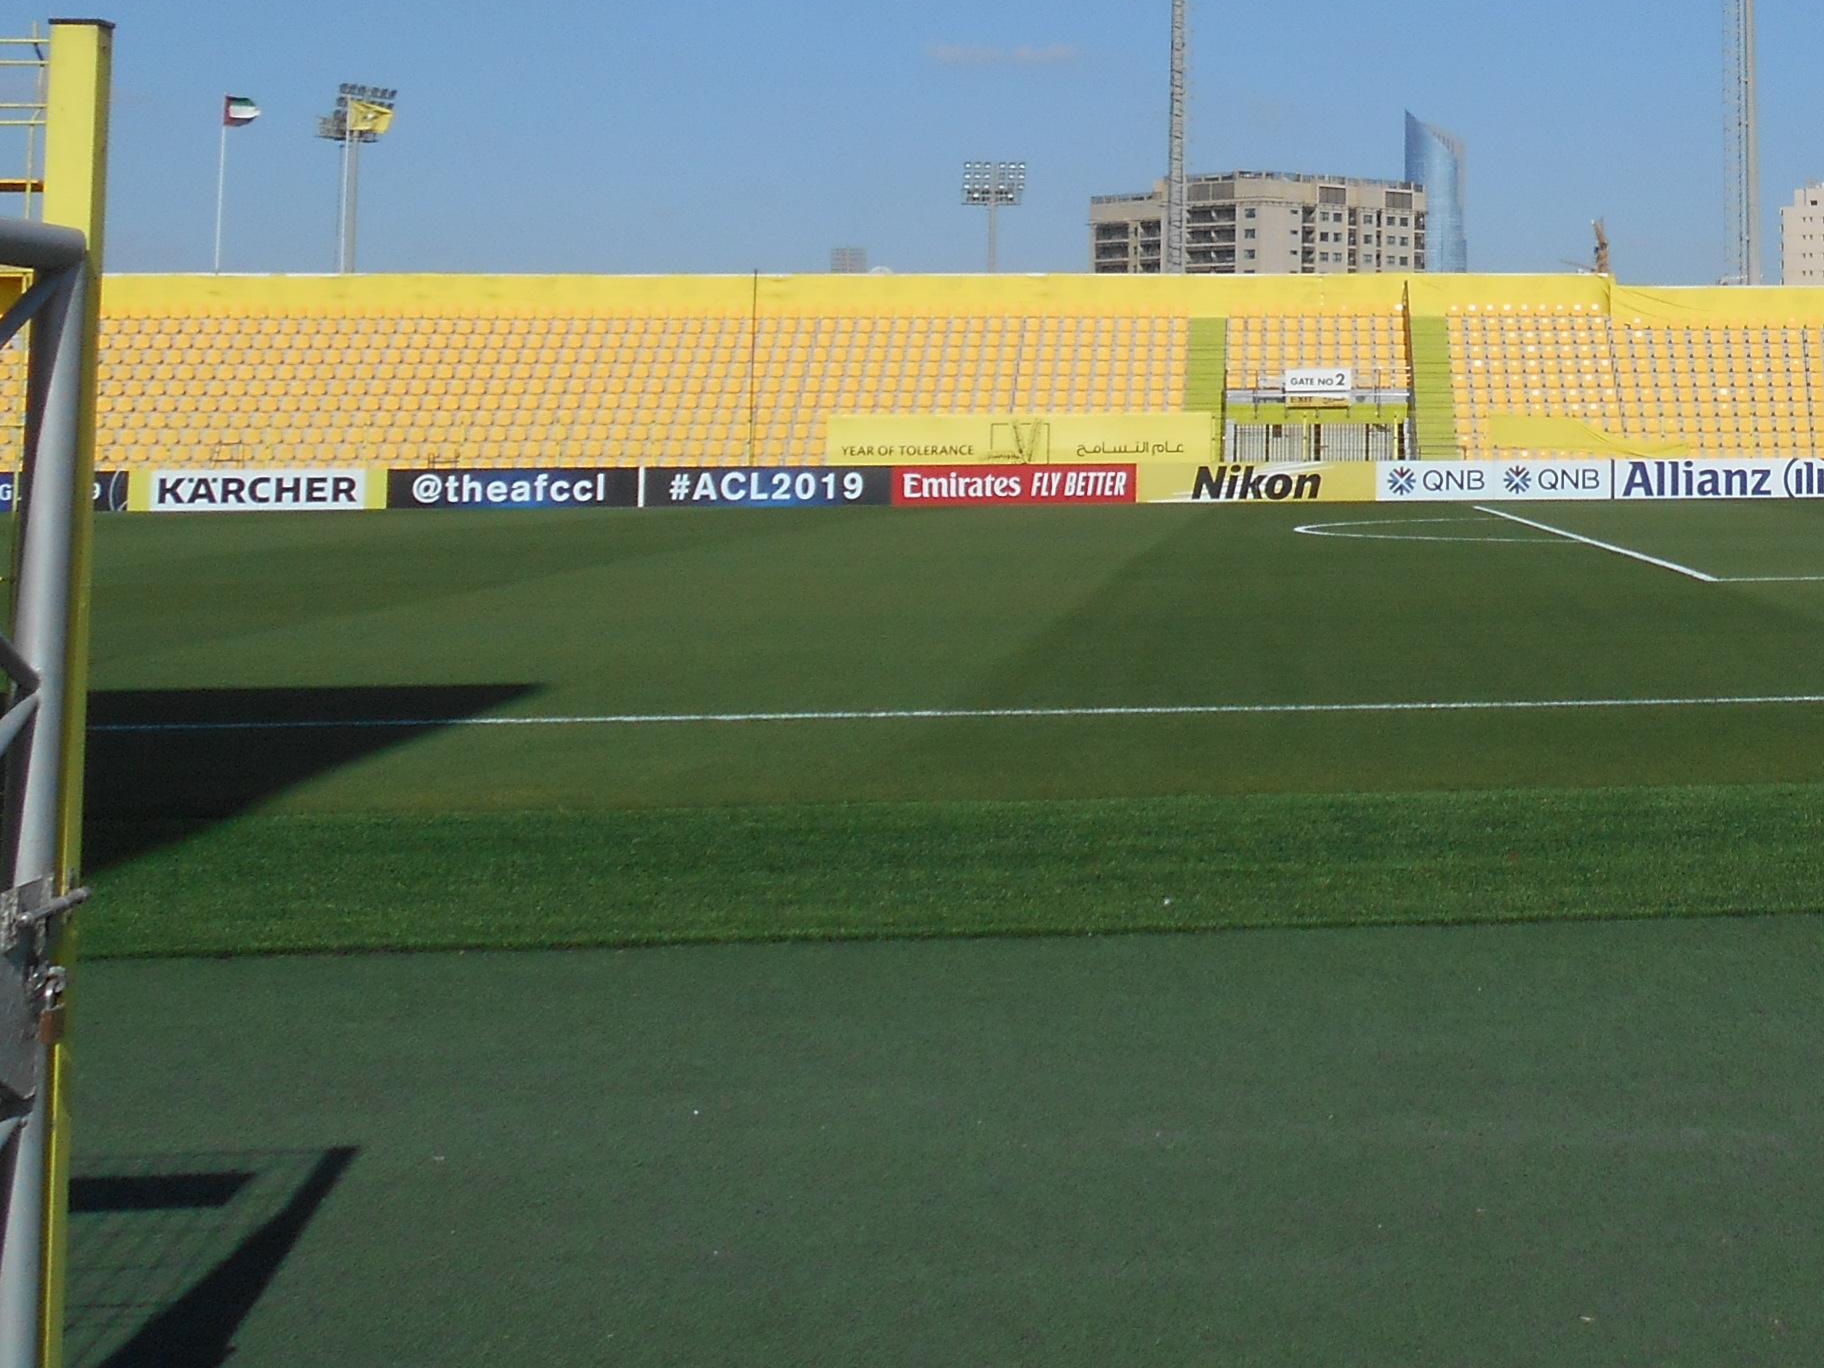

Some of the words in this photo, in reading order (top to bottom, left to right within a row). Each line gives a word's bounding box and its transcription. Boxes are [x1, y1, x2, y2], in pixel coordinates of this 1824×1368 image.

[1290, 377, 1314, 386] GATE
[1317, 377, 1334, 386] NO
[1335, 373, 1345, 386] 2
[841, 445, 875, 457] YEAR
[877, 445, 895, 457] OF
[899, 444, 974, 457] TOLERANCE
[1075, 439, 1150, 457] التسامح
[1151, 440, 1185, 455] عام
[156, 475, 358, 504] KÄRCHER
[411, 473, 605, 504] @theafccl
[669, 471, 865, 501] #ACL2019
[902, 472, 1021, 500] Emirates
[1030, 471, 1061, 498] FLY
[1065, 470, 1127, 497] BETTER
[1191, 465, 1322, 500] Nikon
[1421, 469, 1485, 494] QNB
[1537, 469, 1600, 493] QNB
[1621, 460, 1772, 497] Allianz
